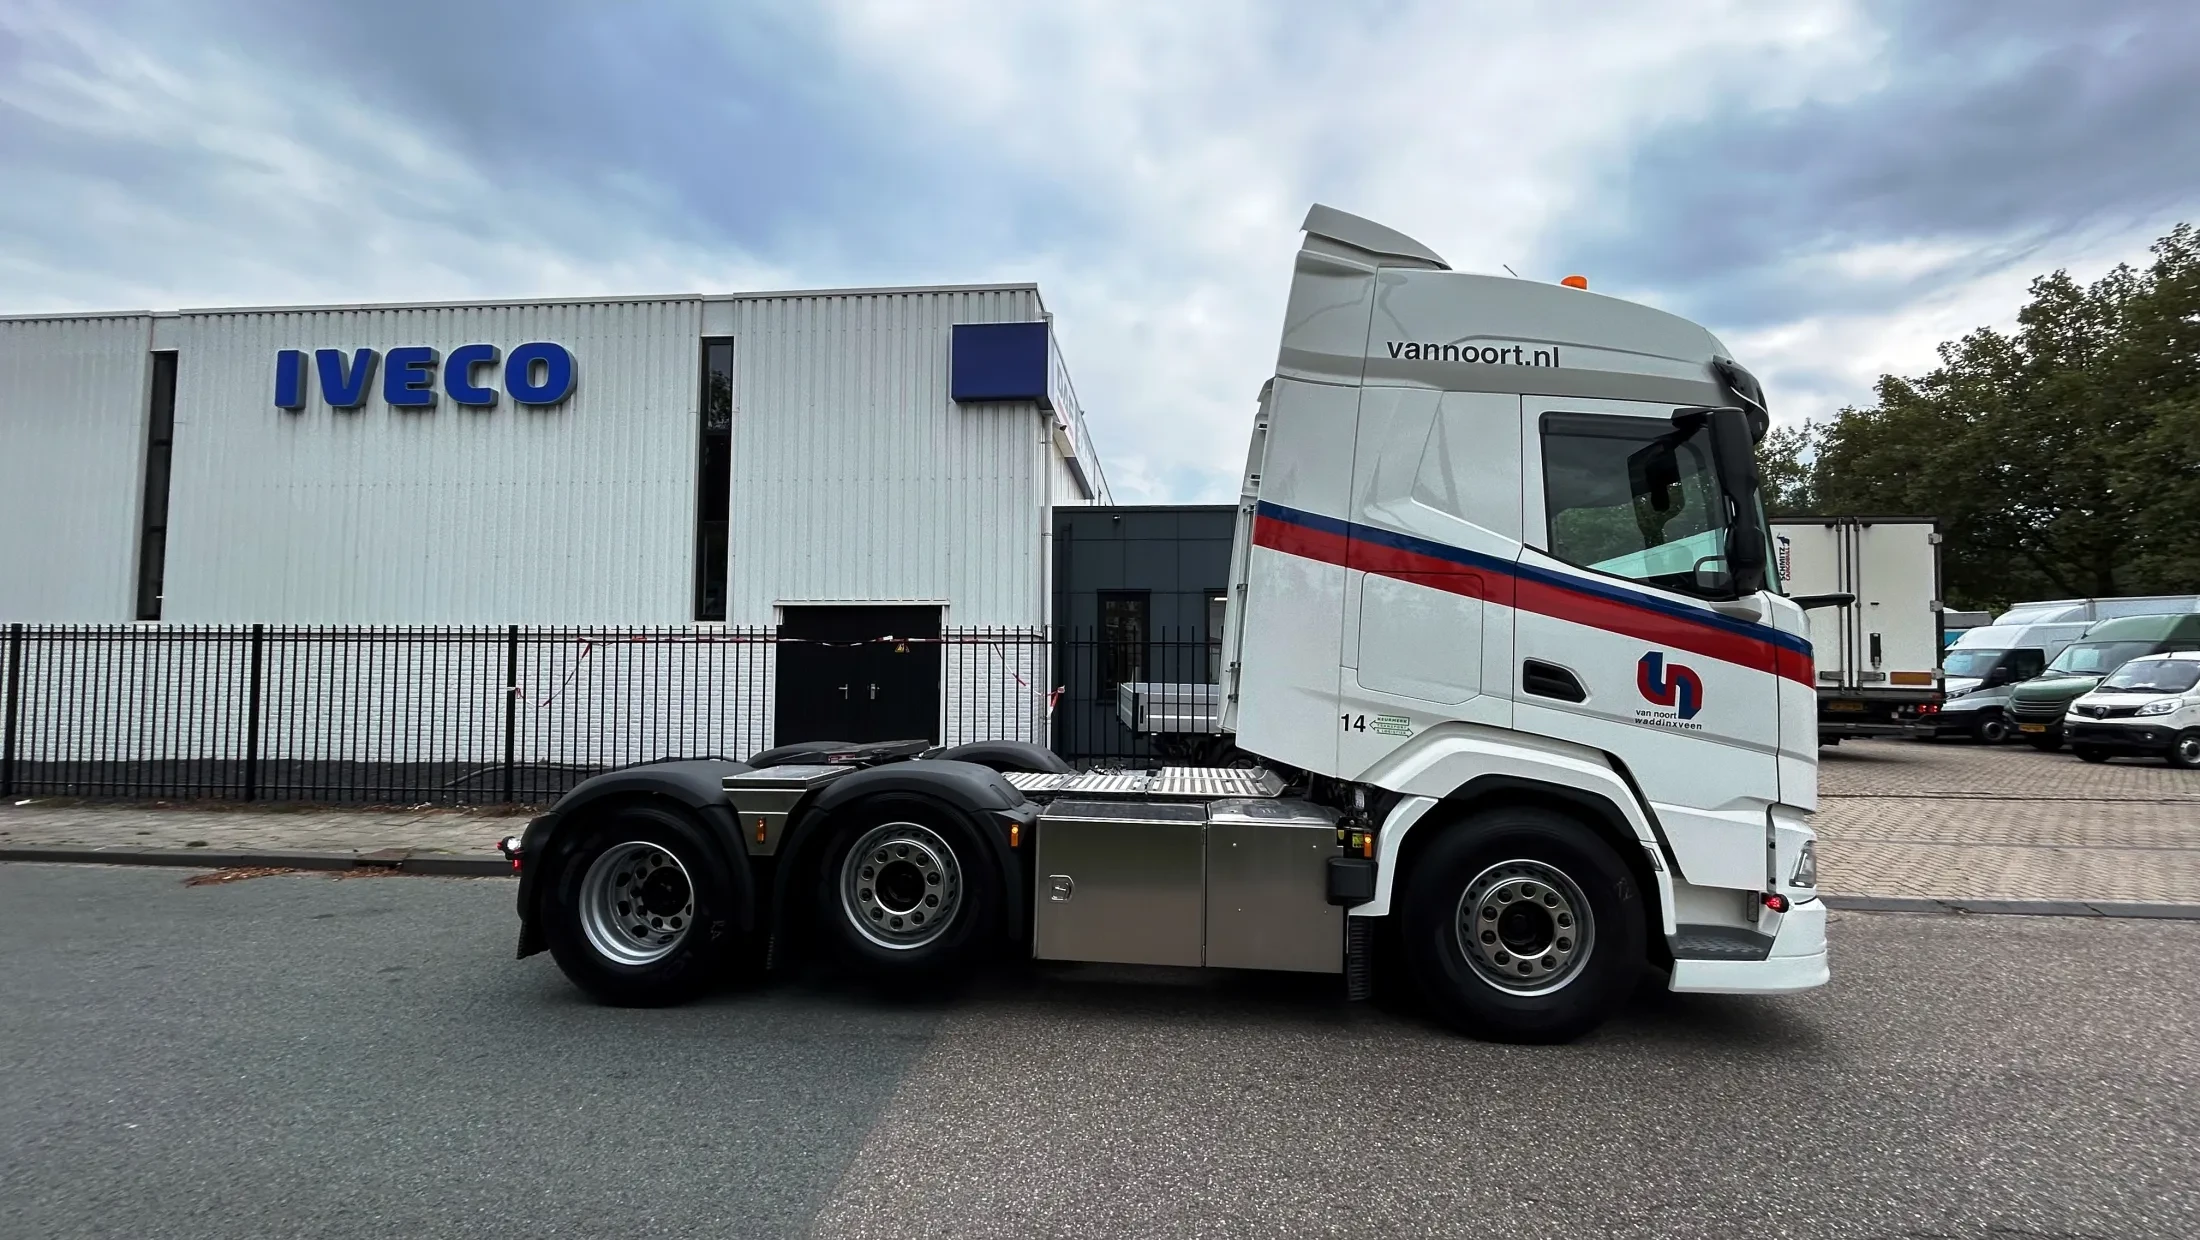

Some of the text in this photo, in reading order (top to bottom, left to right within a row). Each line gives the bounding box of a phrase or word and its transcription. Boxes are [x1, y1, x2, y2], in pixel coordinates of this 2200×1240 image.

[1387, 341, 1559, 368] vannoort.nl
[275, 342, 577, 408] IVECO
[1341, 713, 1366, 733] 14
[1635, 718, 1702, 730] waddinxveen
[1636, 709, 1677, 719] van noort
